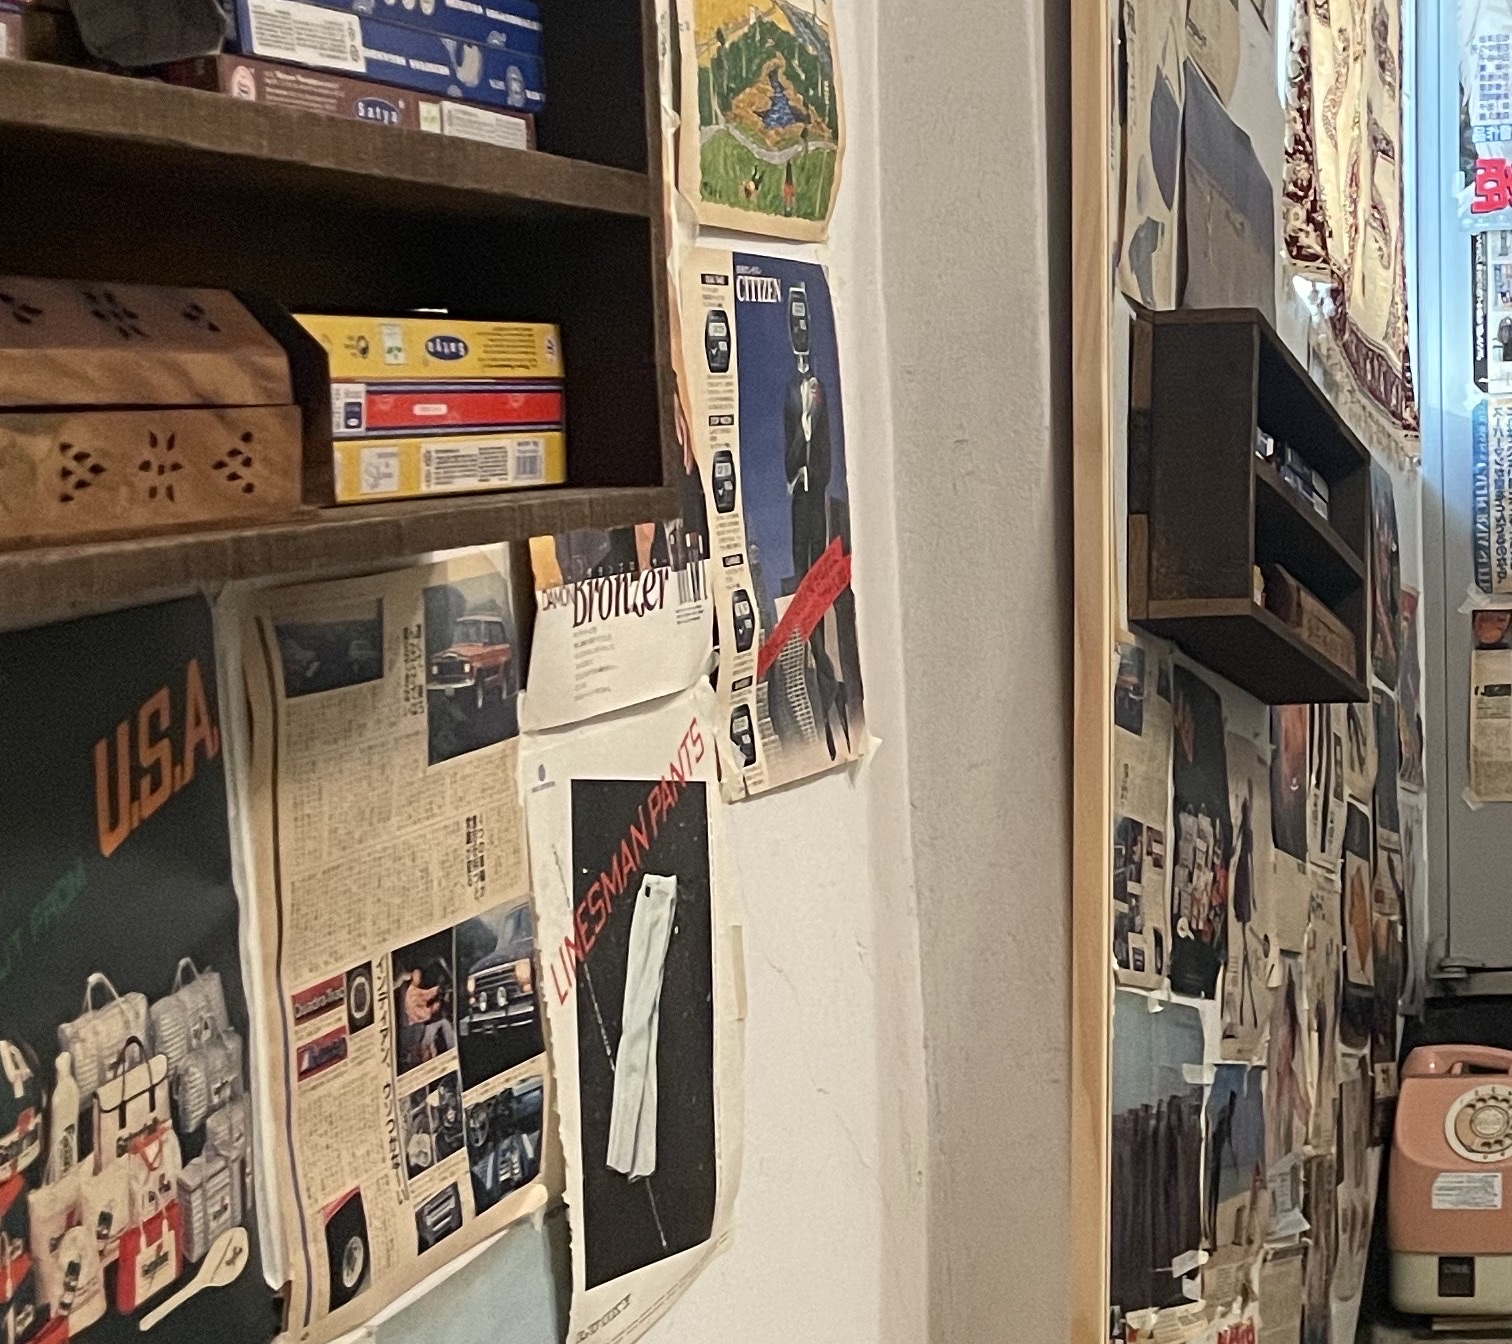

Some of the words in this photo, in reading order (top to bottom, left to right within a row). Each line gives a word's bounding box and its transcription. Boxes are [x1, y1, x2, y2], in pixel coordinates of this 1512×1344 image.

[357, 101, 399, 125] Satya
[736, 275, 782, 303] CITIZEN
[572, 566, 670, 629] Bronzer
[94, 658, 220, 857] U.S.A.
[550, 804, 650, 1006] LINESMAN
[646, 717, 705, 838] PANTS
